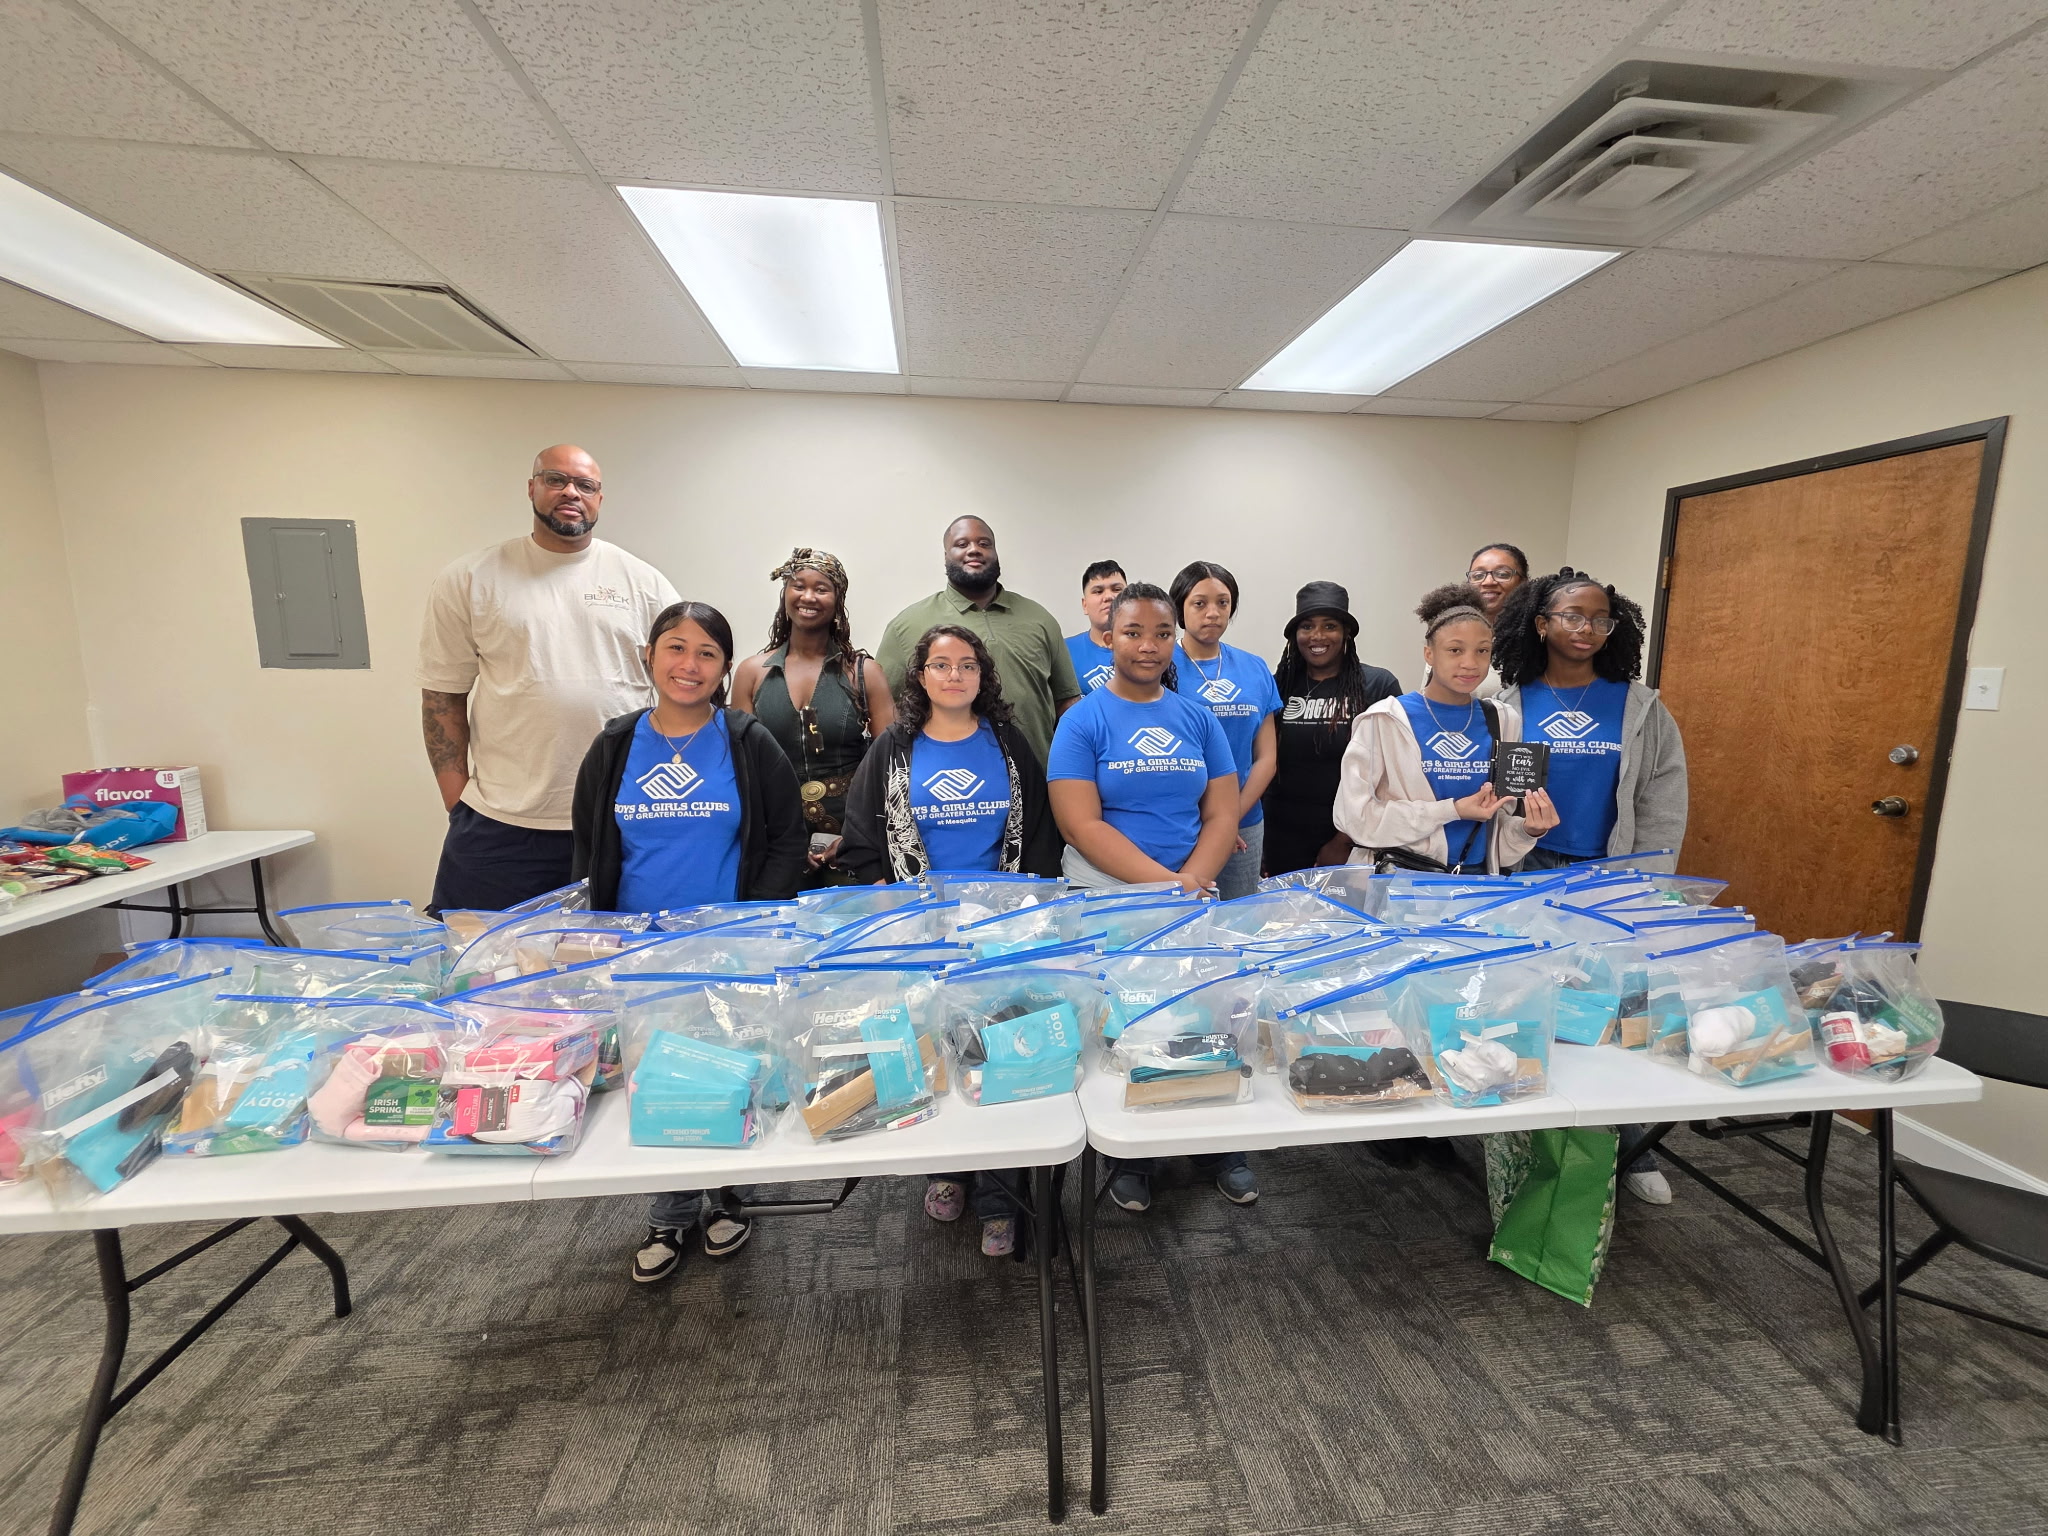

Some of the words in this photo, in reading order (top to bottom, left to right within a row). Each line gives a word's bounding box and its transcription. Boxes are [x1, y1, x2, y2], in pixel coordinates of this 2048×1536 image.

[1588, 741, 1622, 751] CLUBS
[1108, 760, 1135, 770] BOYS
[1137, 758, 1146, 766] &
[1148, 758, 1178, 766] GIRLS
[1180, 758, 1206, 767] CLUBS
[1507, 753, 1534, 766] Fear
[1136, 765, 1168, 773] GREATER
[163, 773, 174, 781] 18
[95, 788, 153, 801] flavor
[638, 804, 649, 813] &
[651, 802, 688, 812] GIRLS
[690, 802, 730, 812] CLUBS
[930, 805, 940, 813] &
[942, 802, 975, 812] GIRLS
[977, 800, 1010, 809] CLUBS
[929, 811, 964, 819] GREATER
[945, 817, 977, 825] Mesquite
[1120, 992, 1154, 1004] Hefty
[1050, 1012, 1067, 1048] BODY
[48, 1070, 104, 1106] Hefty
[244, 1096, 298, 1109] BODY
[368, 1106, 402, 1114] SPRING
